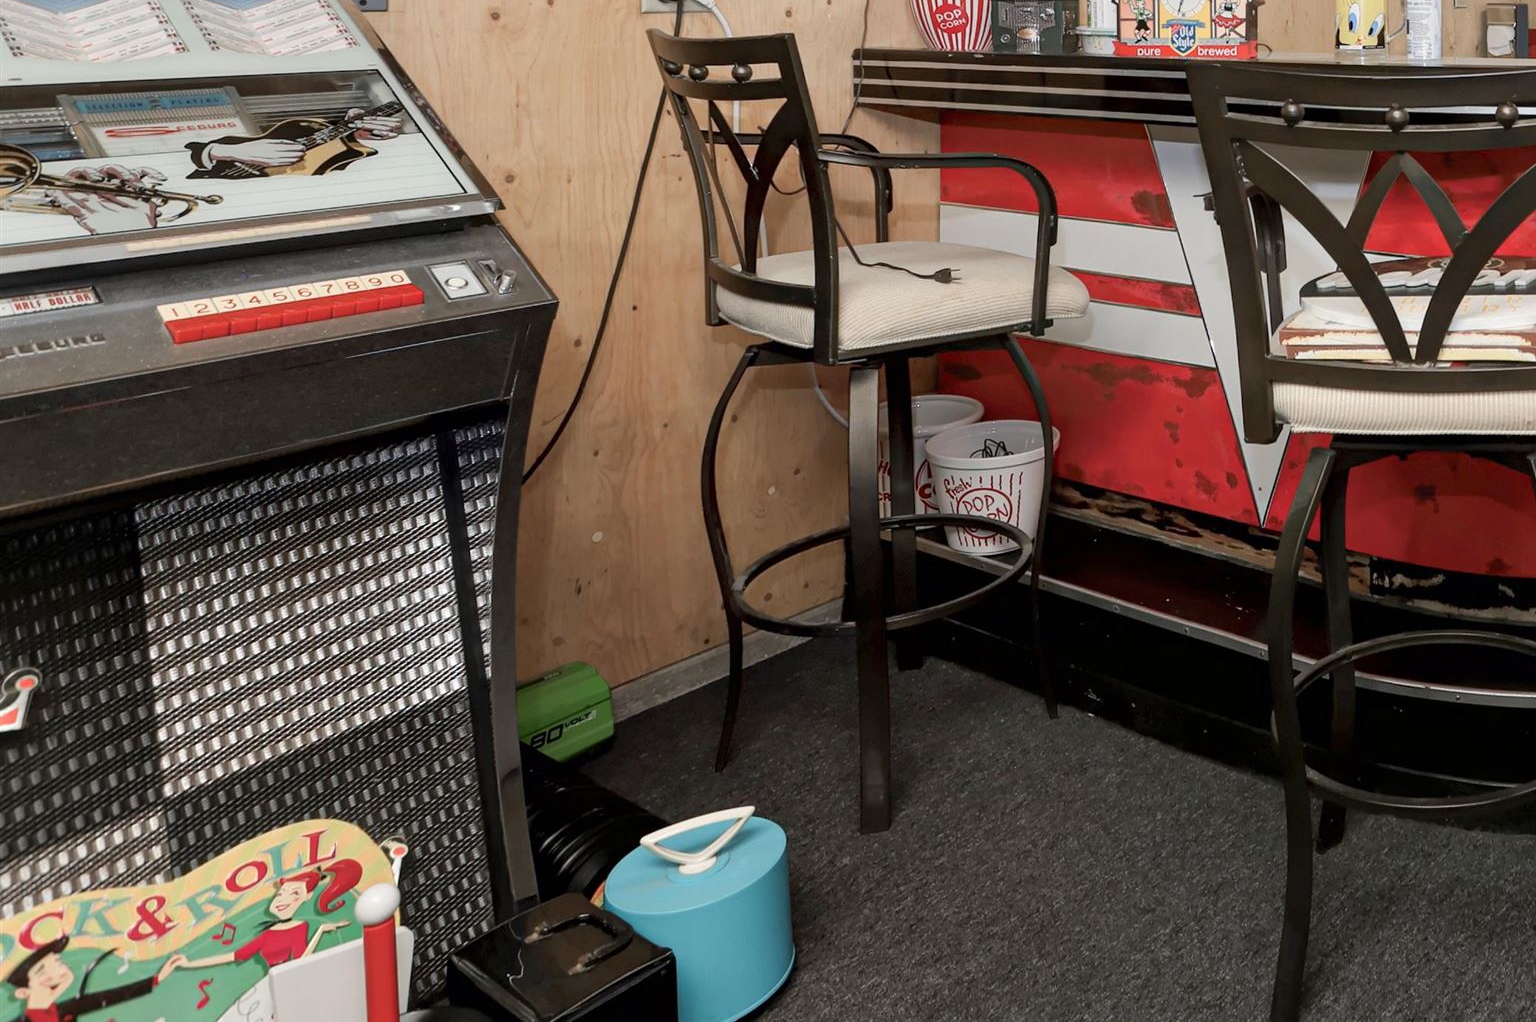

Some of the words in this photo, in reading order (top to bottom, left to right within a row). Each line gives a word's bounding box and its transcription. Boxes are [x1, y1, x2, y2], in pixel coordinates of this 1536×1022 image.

[936, 9, 962, 24] POP
[940, 18, 967, 30] CORN
[1179, 25, 1194, 38] Old
[1136, 47, 1162, 56] pure
[1197, 46, 1238, 56] brewed
[1172, 34, 1195, 52] Style
[14, 301, 42, 311] HALF
[48, 292, 92, 307] DOLLAR
[171, 307, 179, 317] 1
[194, 303, 209, 314] 2
[223, 299, 237, 309] 3
[249, 295, 261, 305] 4
[272, 291, 288, 302] 5
[297, 288, 312, 298] 6
[321, 284, 333, 294] 7
[345, 280, 360, 290] 8
[368, 277, 382, 287] 9
[390, 274, 404, 283] 0
[943, 479, 971, 499] fresh
[962, 495, 995, 514] POP
[565, 711, 593, 728] VOLT
